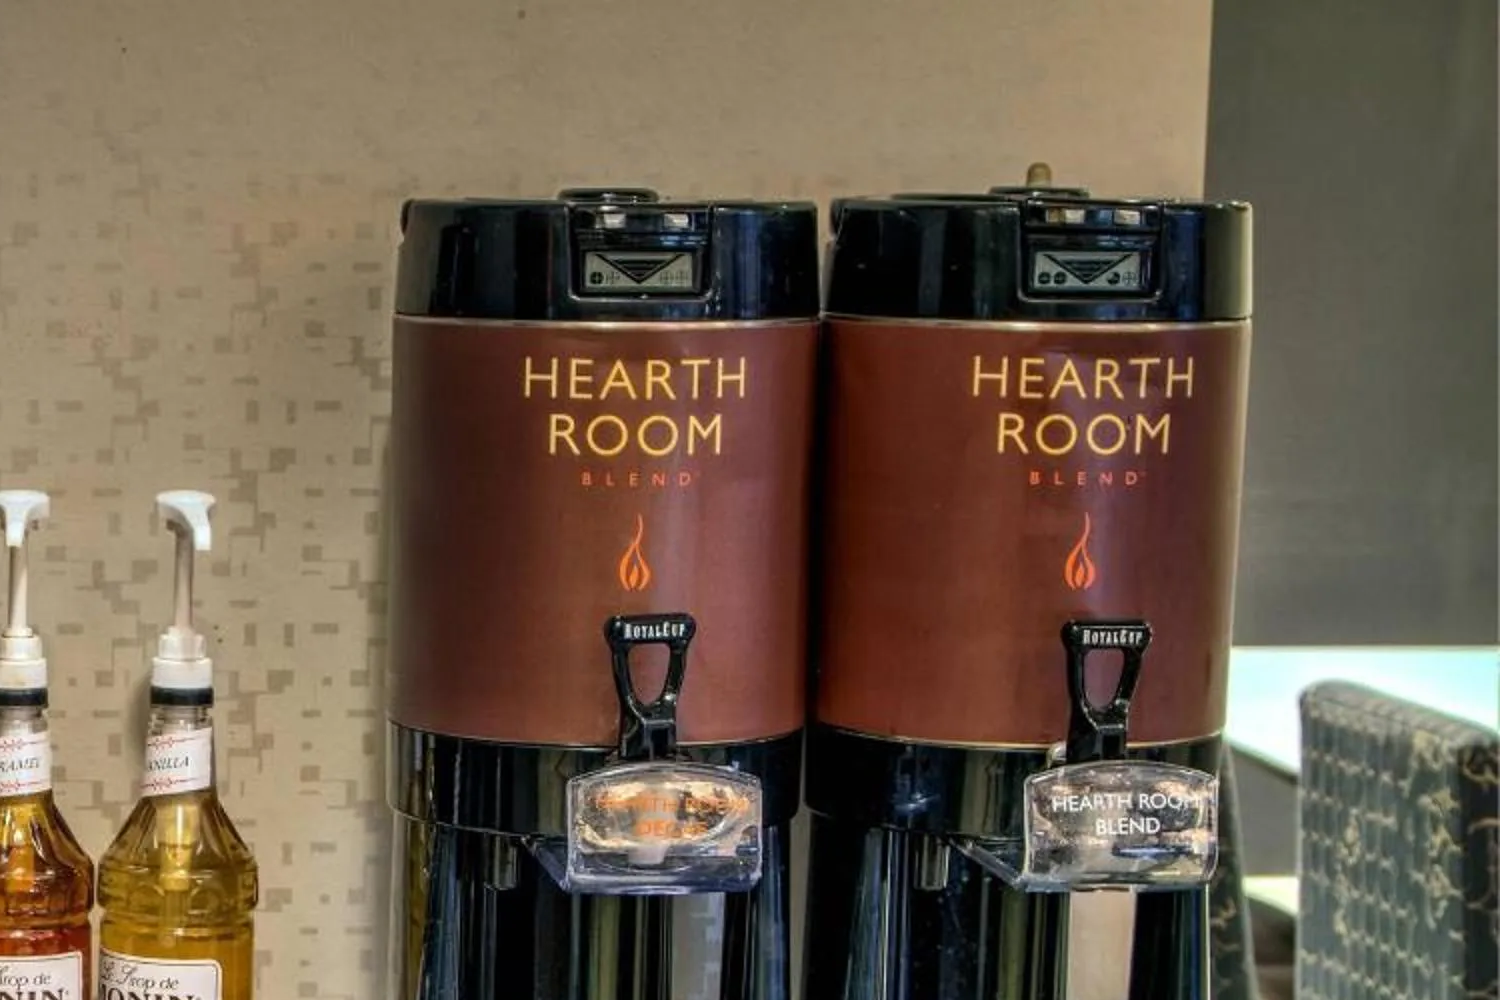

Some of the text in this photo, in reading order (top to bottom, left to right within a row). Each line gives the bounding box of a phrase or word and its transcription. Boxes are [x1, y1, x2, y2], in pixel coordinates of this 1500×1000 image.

[524, 356, 746, 400] HEARTH
[973, 355, 1194, 399] HEARTH
[549, 413, 723, 456] ROOM
[996, 413, 1171, 455] ROOM
[581, 471, 692, 487] BLEND
[1029, 471, 1139, 486] BLEND
[1052, 792, 1201, 813] HEARTH ROOM
[1095, 816, 1162, 836] BLEND
[33, 971, 52, 986] de
